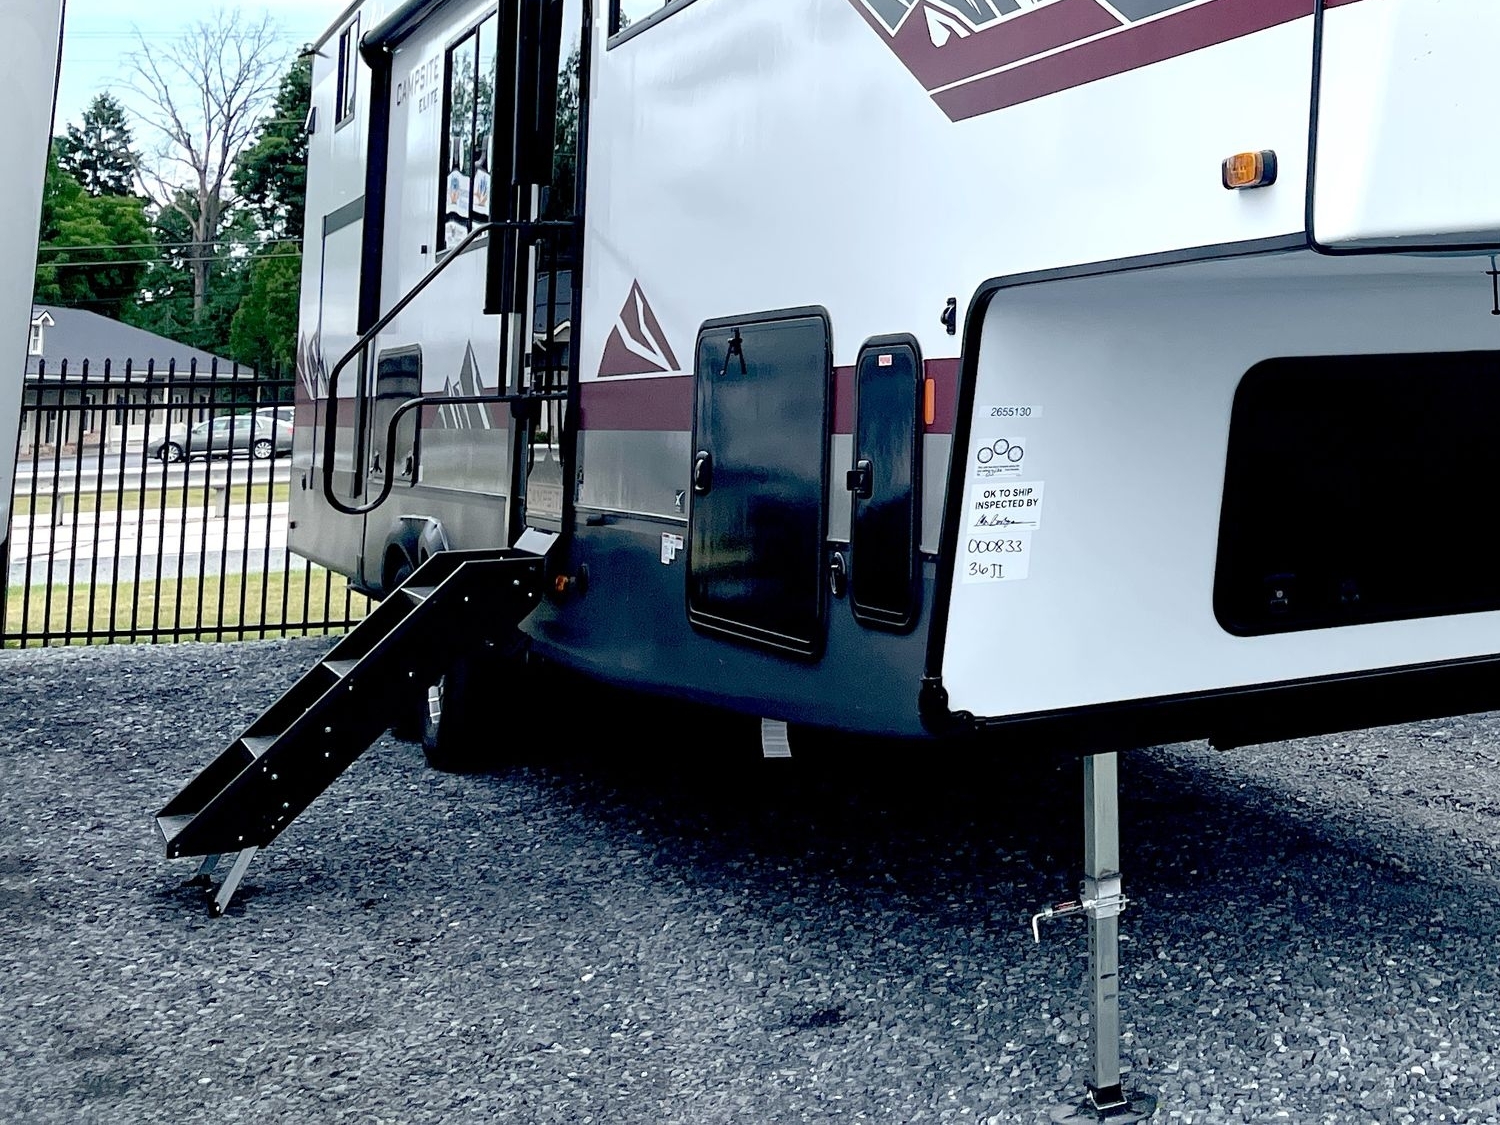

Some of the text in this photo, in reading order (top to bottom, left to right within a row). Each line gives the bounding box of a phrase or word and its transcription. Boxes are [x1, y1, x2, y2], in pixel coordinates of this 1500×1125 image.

[396, 54, 440, 106] CAMPSITE
[418, 87, 439, 114] ELITE
[990, 406, 1032, 417] 2655130
[983, 487, 1033, 499] OK TO SHIP
[975, 498, 1039, 510] INSPECTED BY
